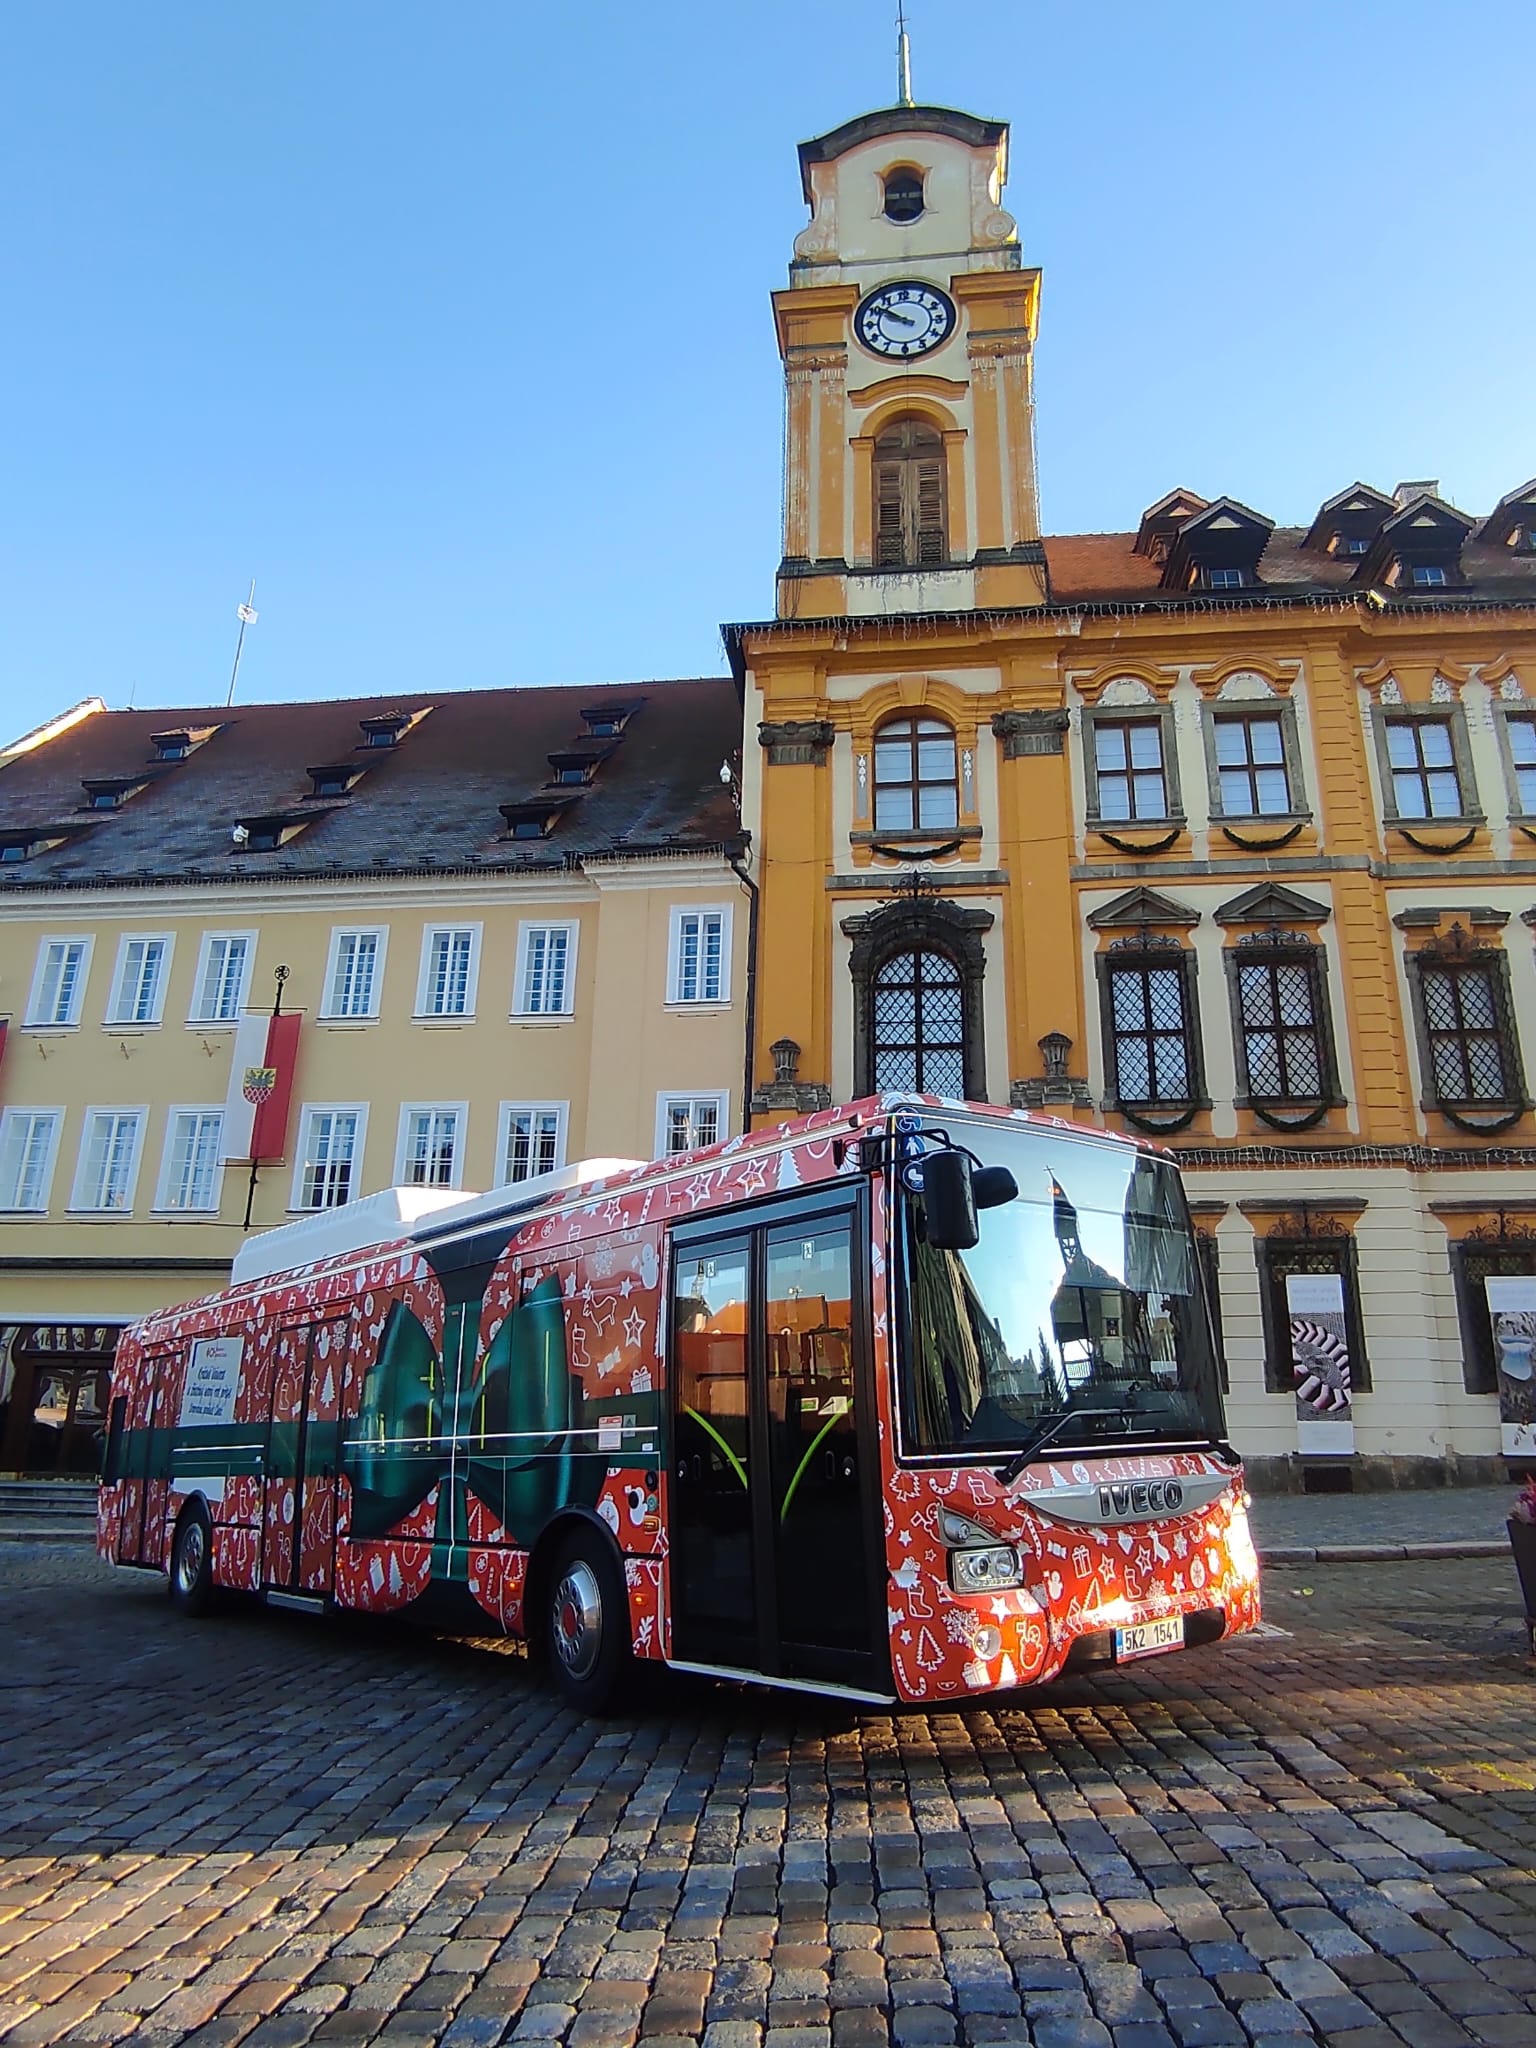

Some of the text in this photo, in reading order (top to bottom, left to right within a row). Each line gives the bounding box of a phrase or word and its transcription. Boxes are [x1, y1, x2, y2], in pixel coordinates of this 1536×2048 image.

[880, 294, 892, 306] 11
[897, 290, 910, 300] 12
[869, 305, 881, 317] 10
[1099, 1479, 1184, 1517] IVECO
[1125, 1620, 1179, 1651] 5K2 1541
